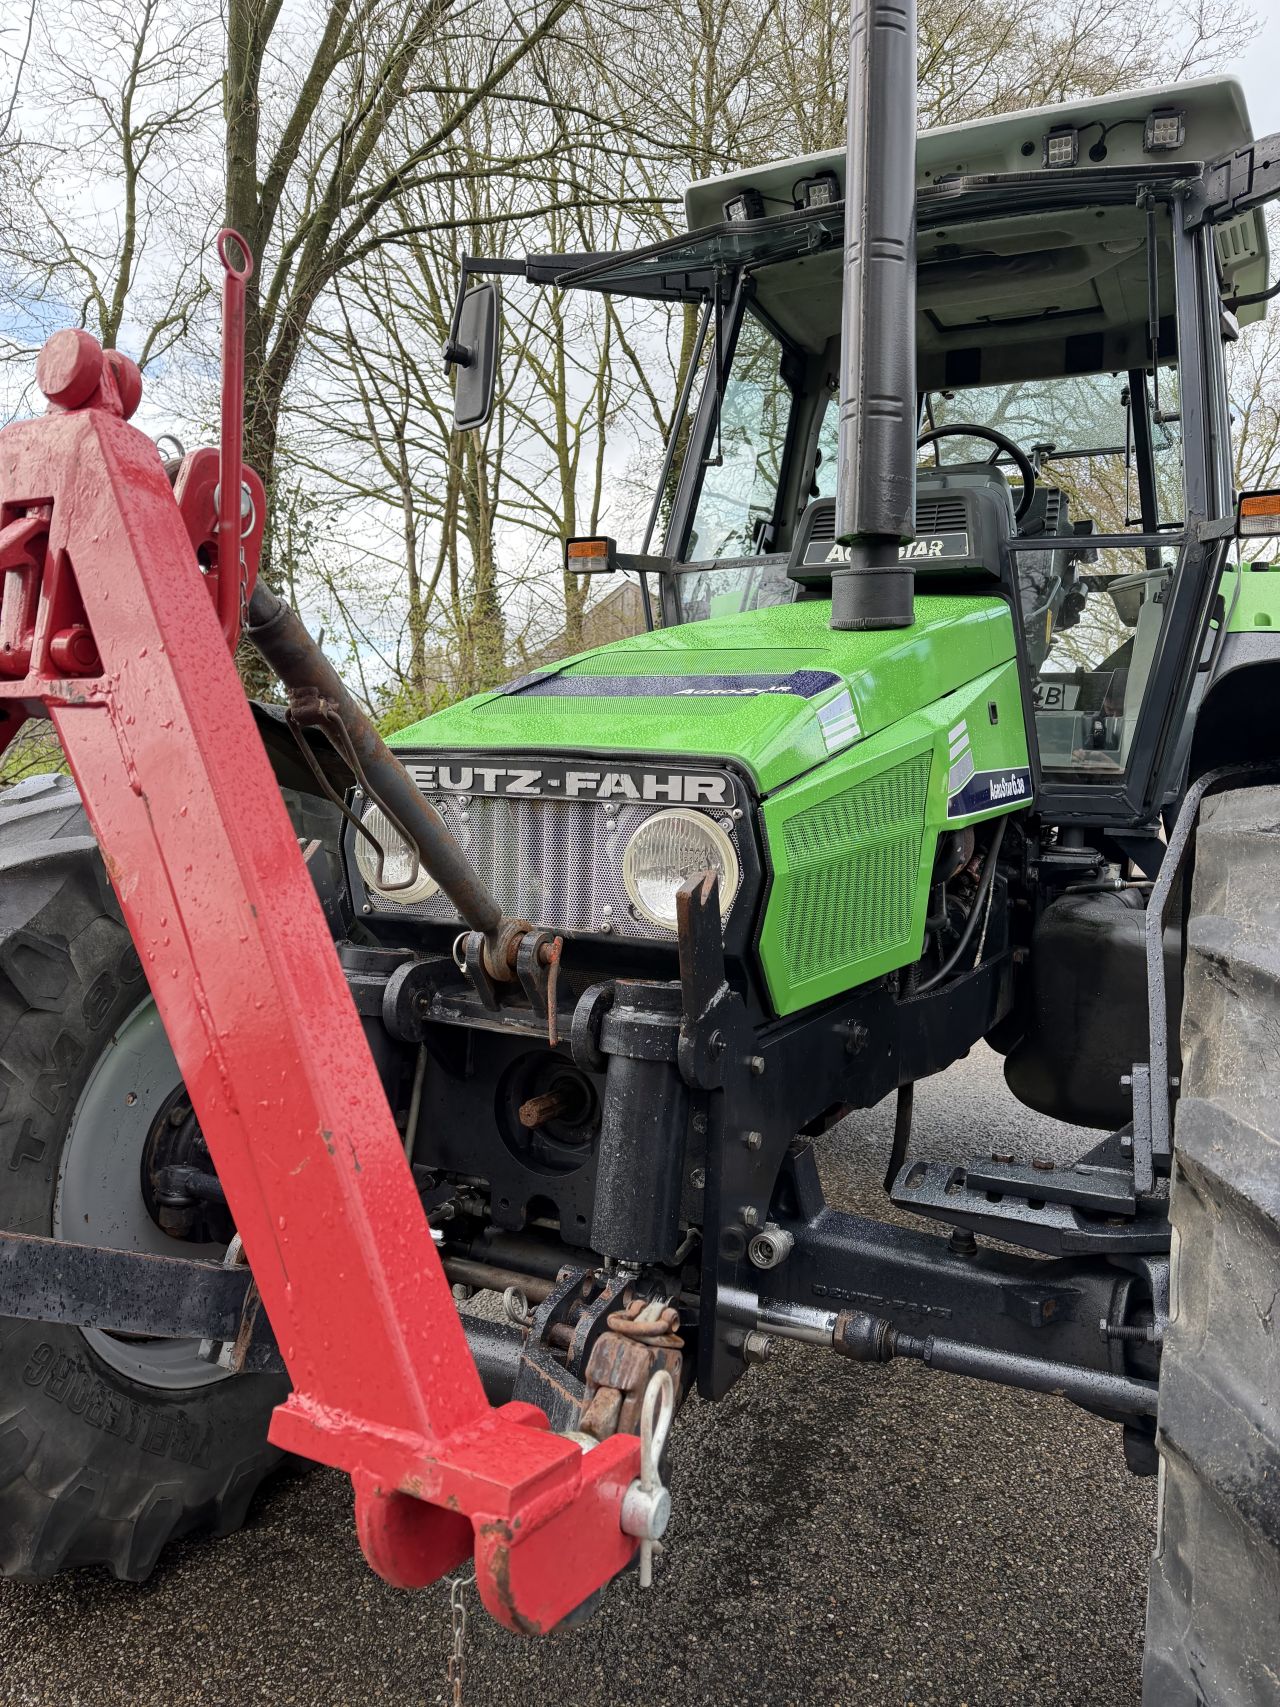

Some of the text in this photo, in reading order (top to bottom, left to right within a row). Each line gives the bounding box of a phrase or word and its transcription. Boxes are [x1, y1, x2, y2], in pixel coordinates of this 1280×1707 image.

[824, 541, 944, 562] ASTAR
[405, 765, 726, 803] EUTZ-FAHR
[22, 1341, 214, 1470] TRELLEBORG
